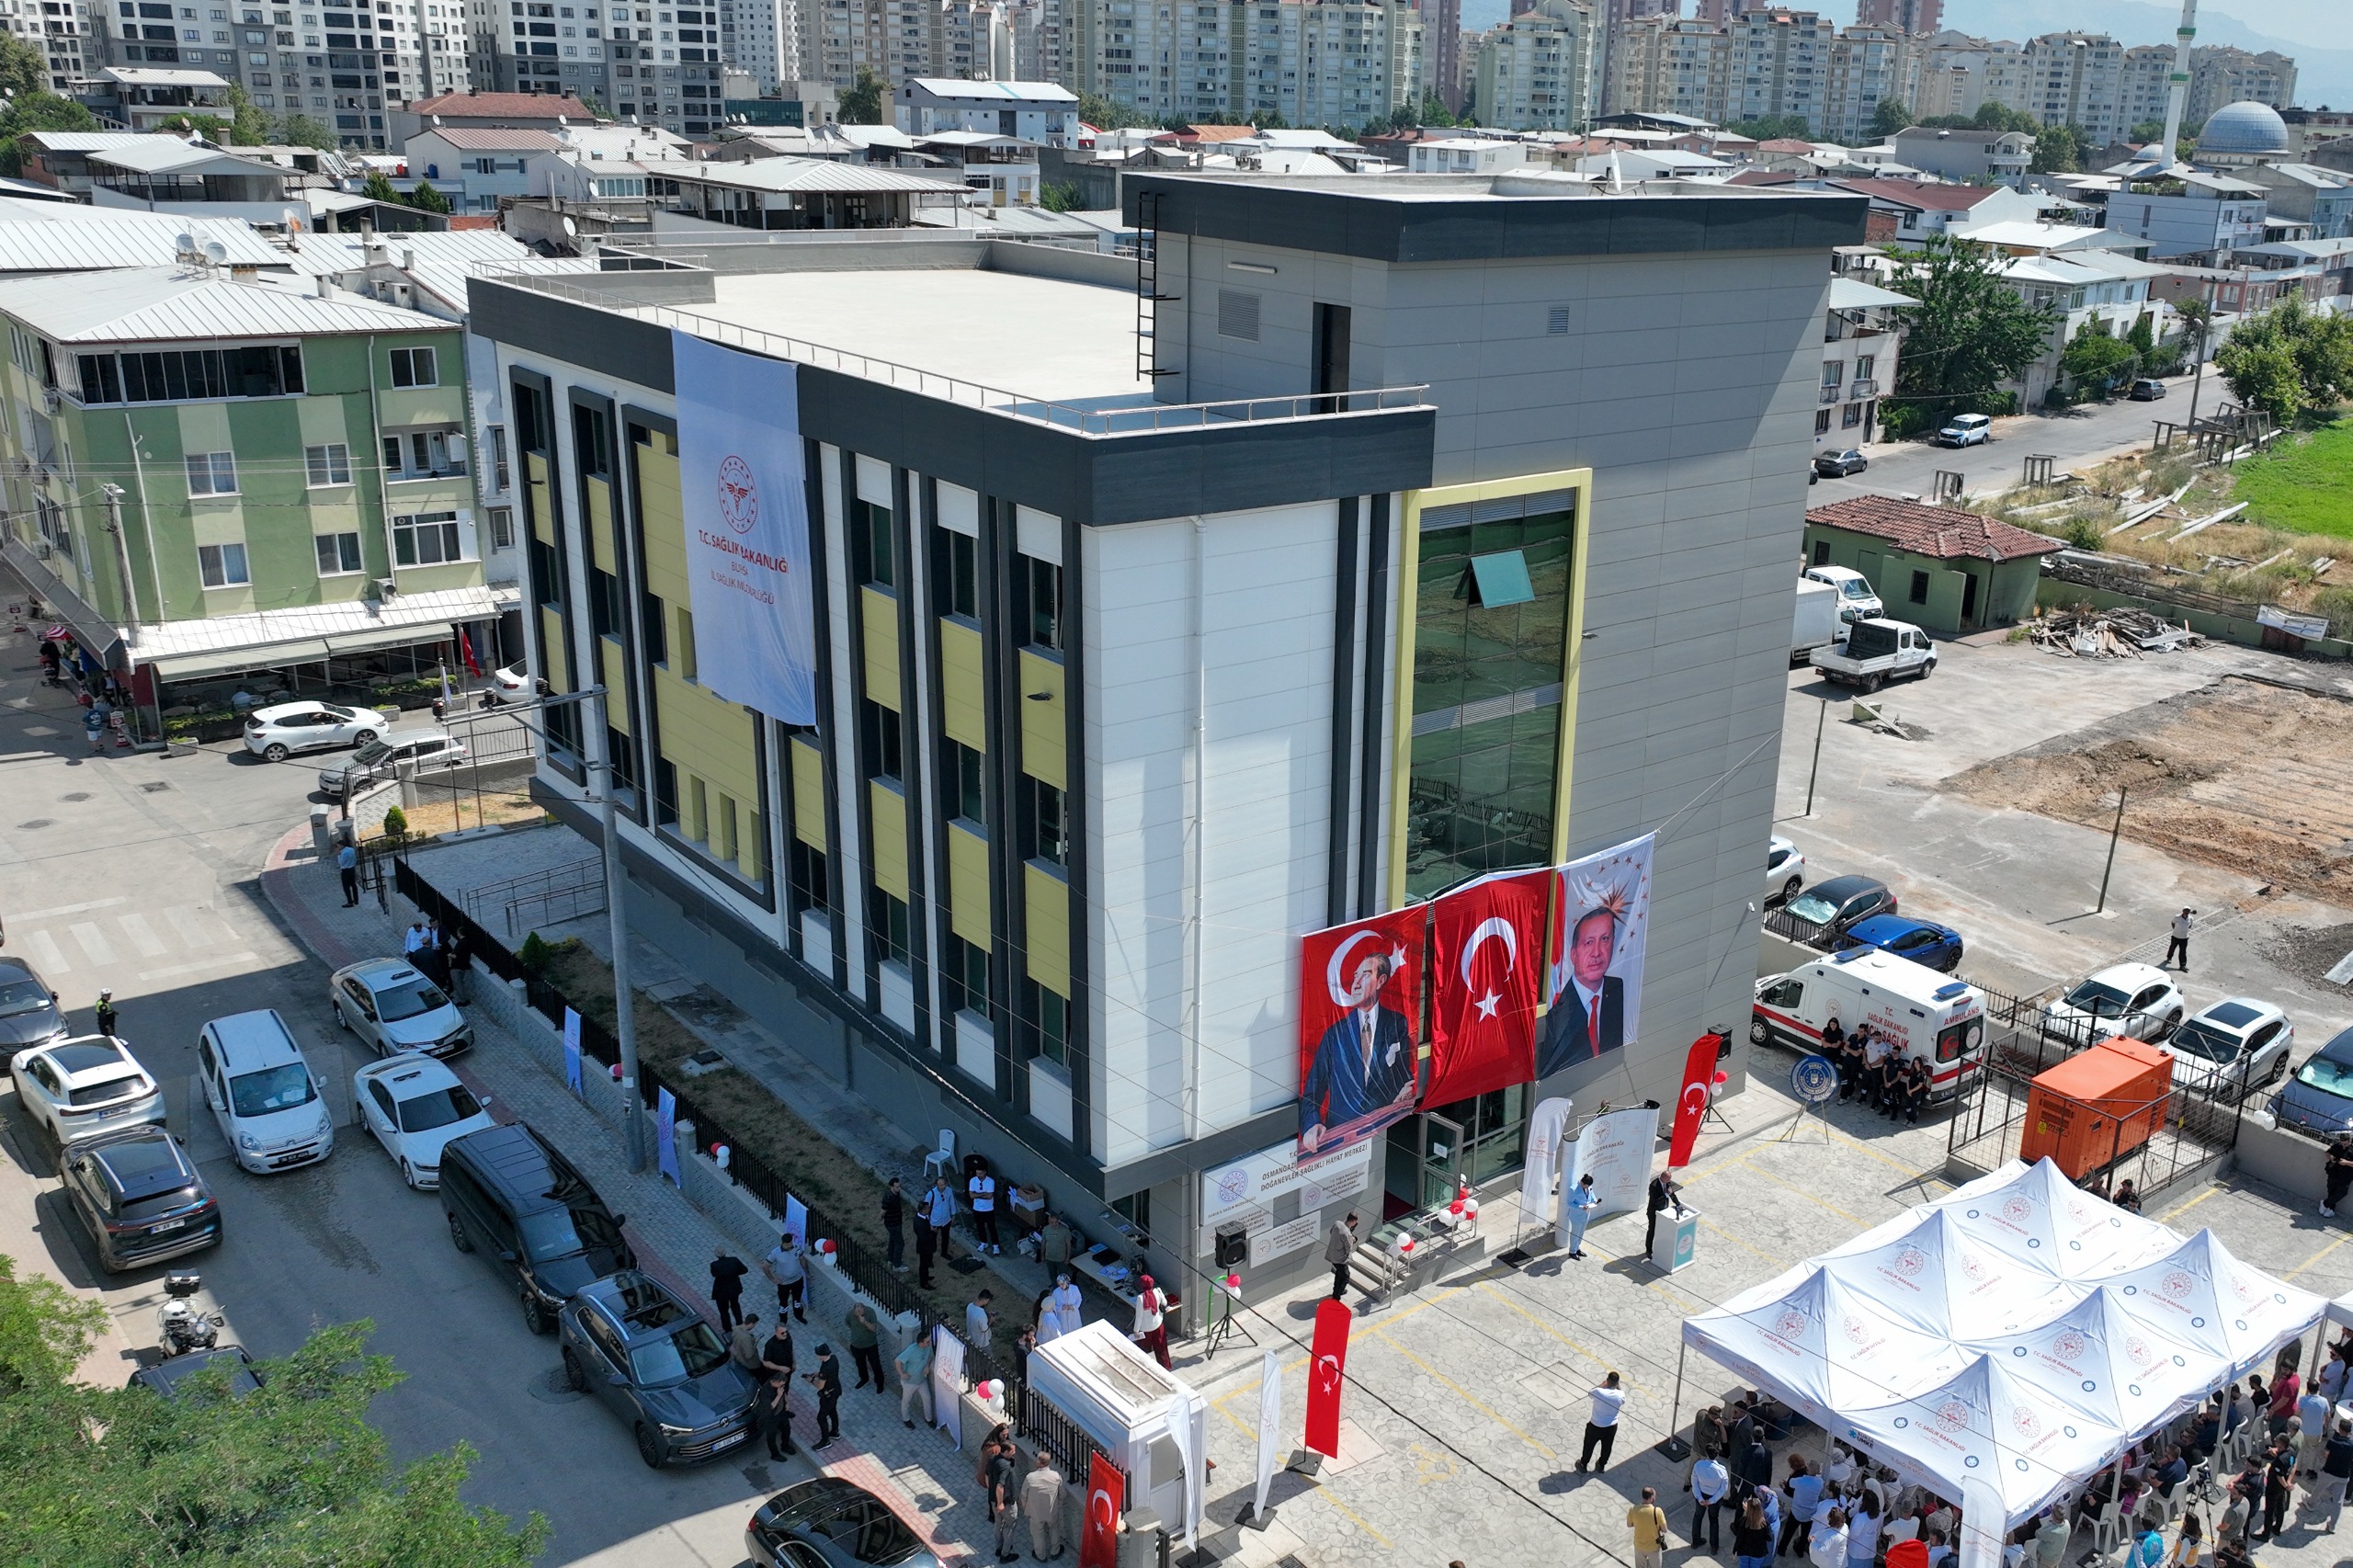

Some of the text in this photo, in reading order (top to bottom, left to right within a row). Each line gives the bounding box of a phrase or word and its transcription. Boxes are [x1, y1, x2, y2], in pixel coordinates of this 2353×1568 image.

[699, 529, 711, 546] T.C.
[711, 535, 741, 556] SAĞLIK
[1885, 1007, 1893, 1017] T.C.
[1943, 1006, 1980, 1026] AMBULANS
[1868, 1013, 1909, 1036] SAĞLIK BAKANLIĞI
[1882, 1030, 1910, 1051] SAĞLIK
[1261, 1142, 1368, 1191] DOĞANEVLER SAĞLIKLI HAYAT MERKEZİ
[1857, 1436, 1874, 1449] UMKE
[1858, 1430, 1875, 1443] BURSA
[1923, 1426, 1939, 1438] SAĞLIK
[1939, 1434, 1966, 1452] BAKANLIĞI
